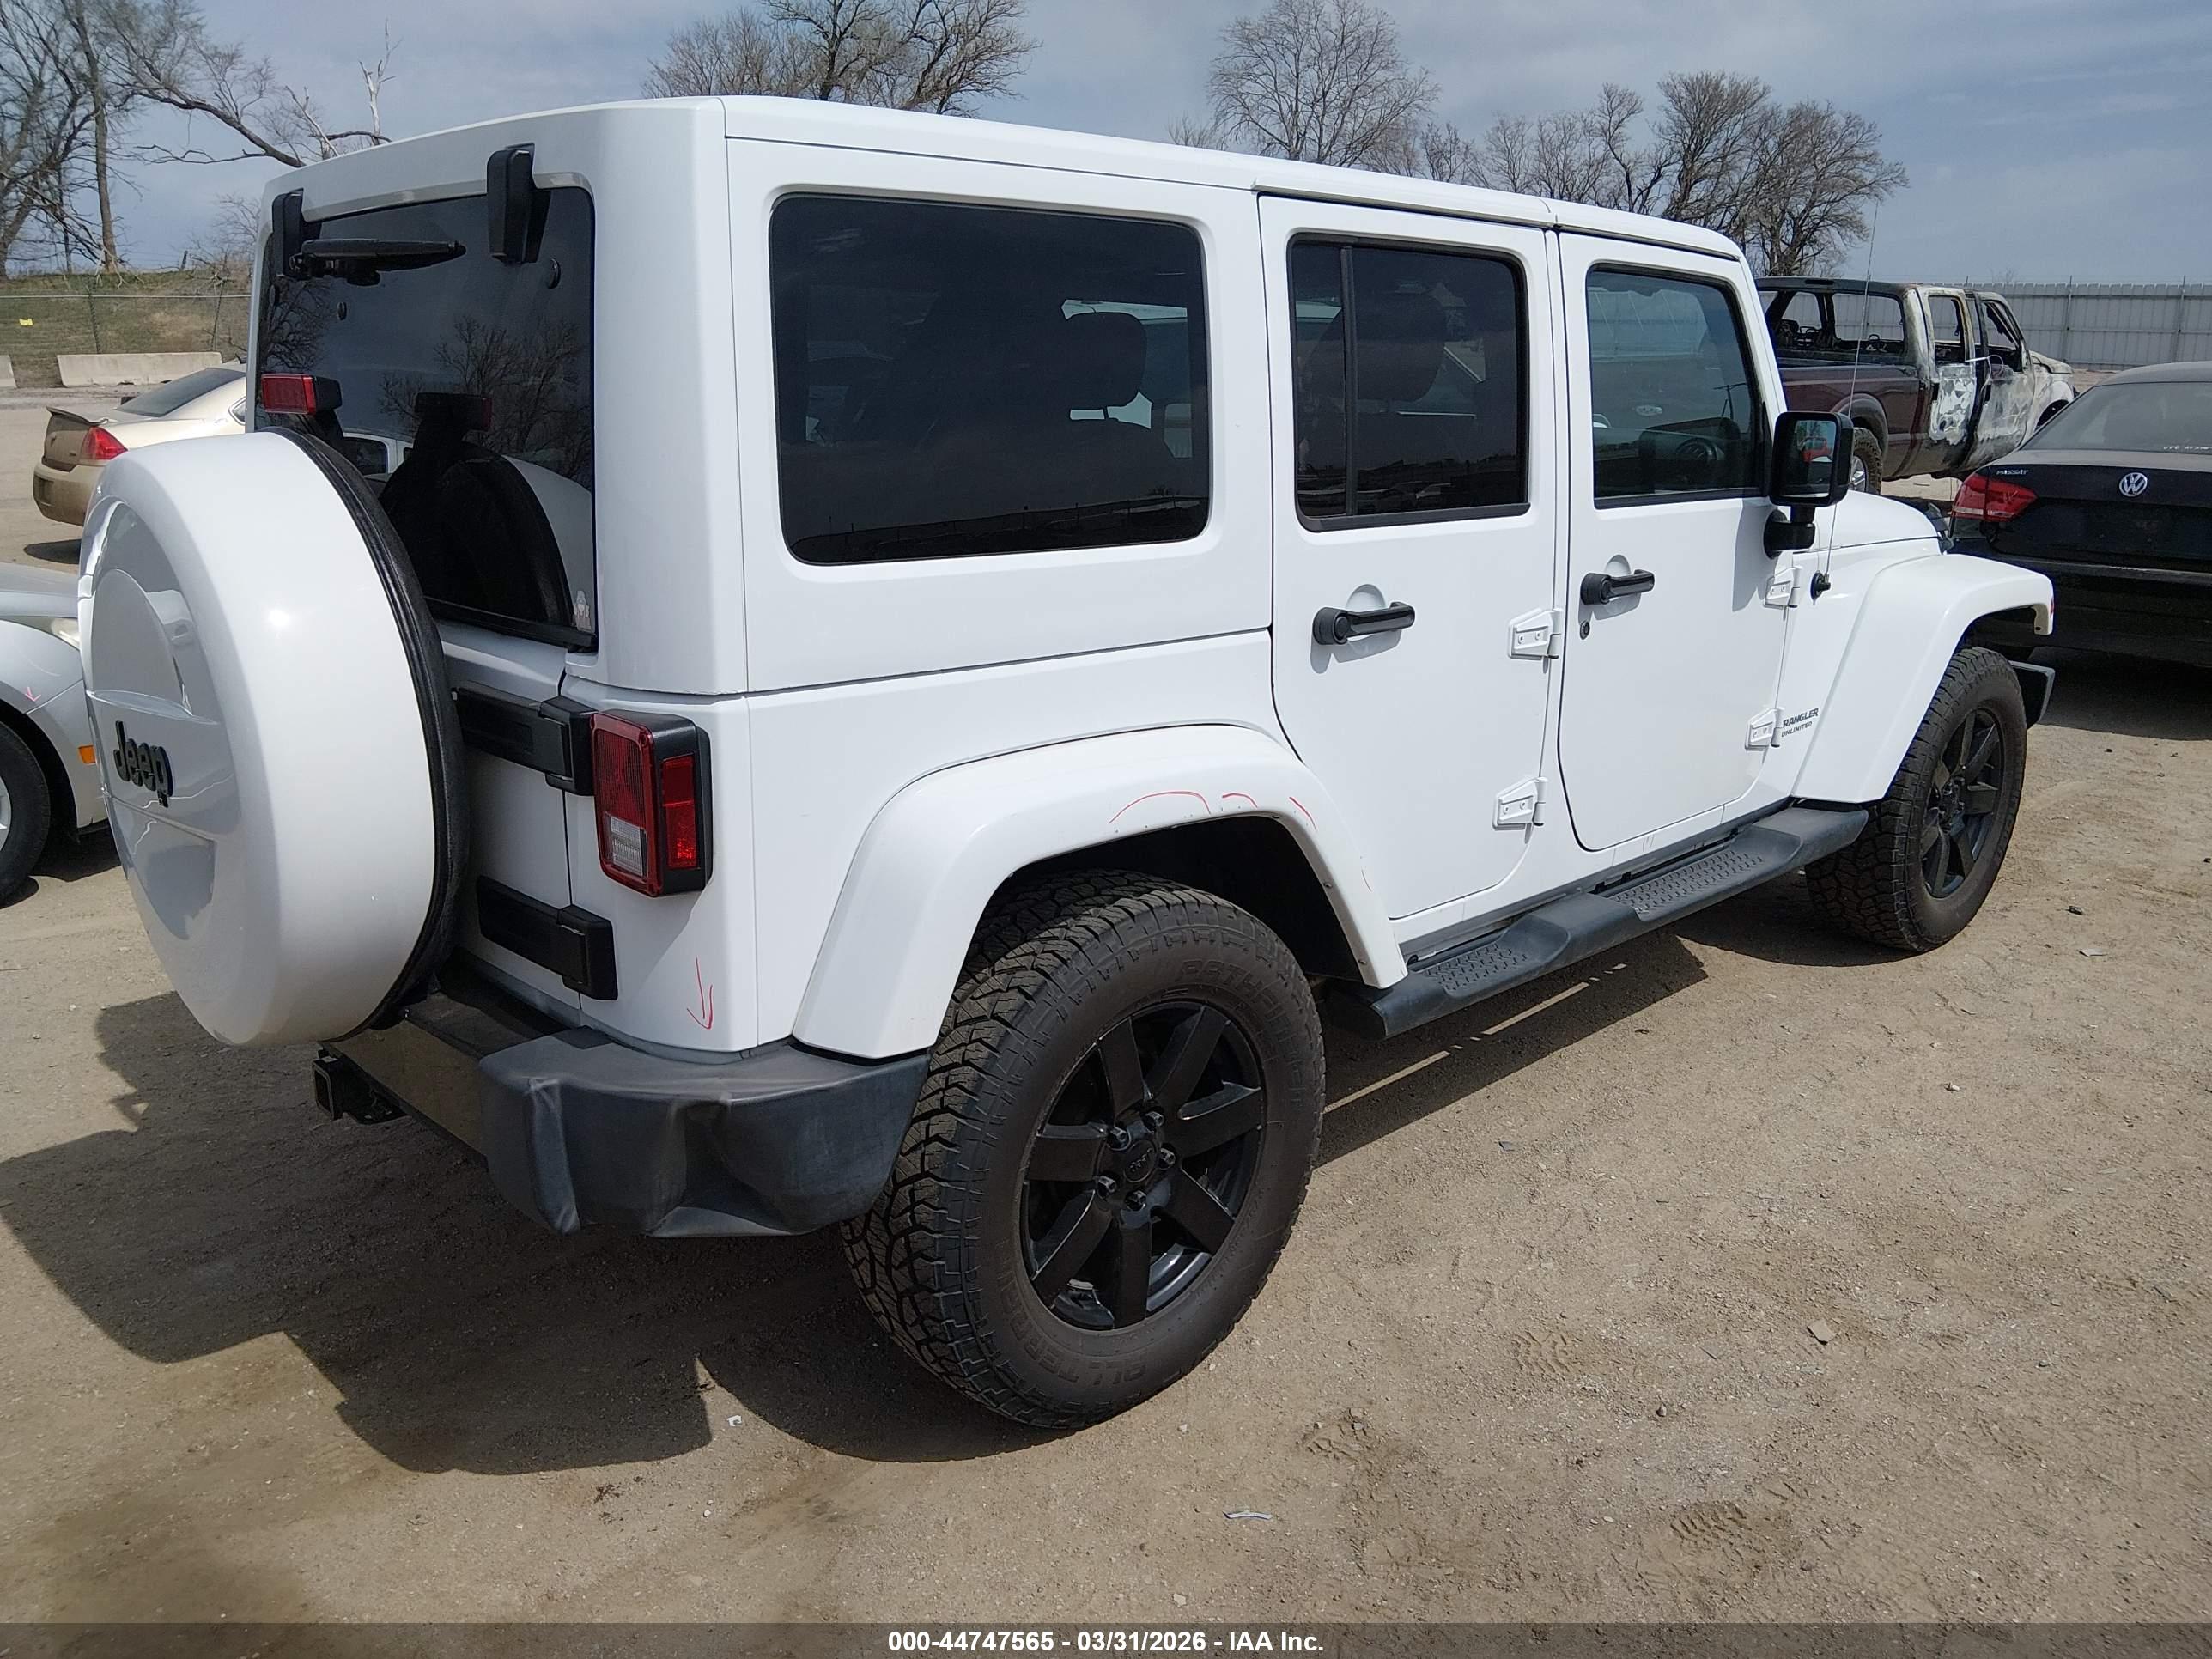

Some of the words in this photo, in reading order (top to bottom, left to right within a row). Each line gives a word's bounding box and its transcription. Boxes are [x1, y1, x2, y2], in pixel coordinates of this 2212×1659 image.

[1783, 708, 1819, 727] RANGLER
[1781, 721, 1812, 737] UNLIMITED
[113, 720, 173, 808] Jeep
